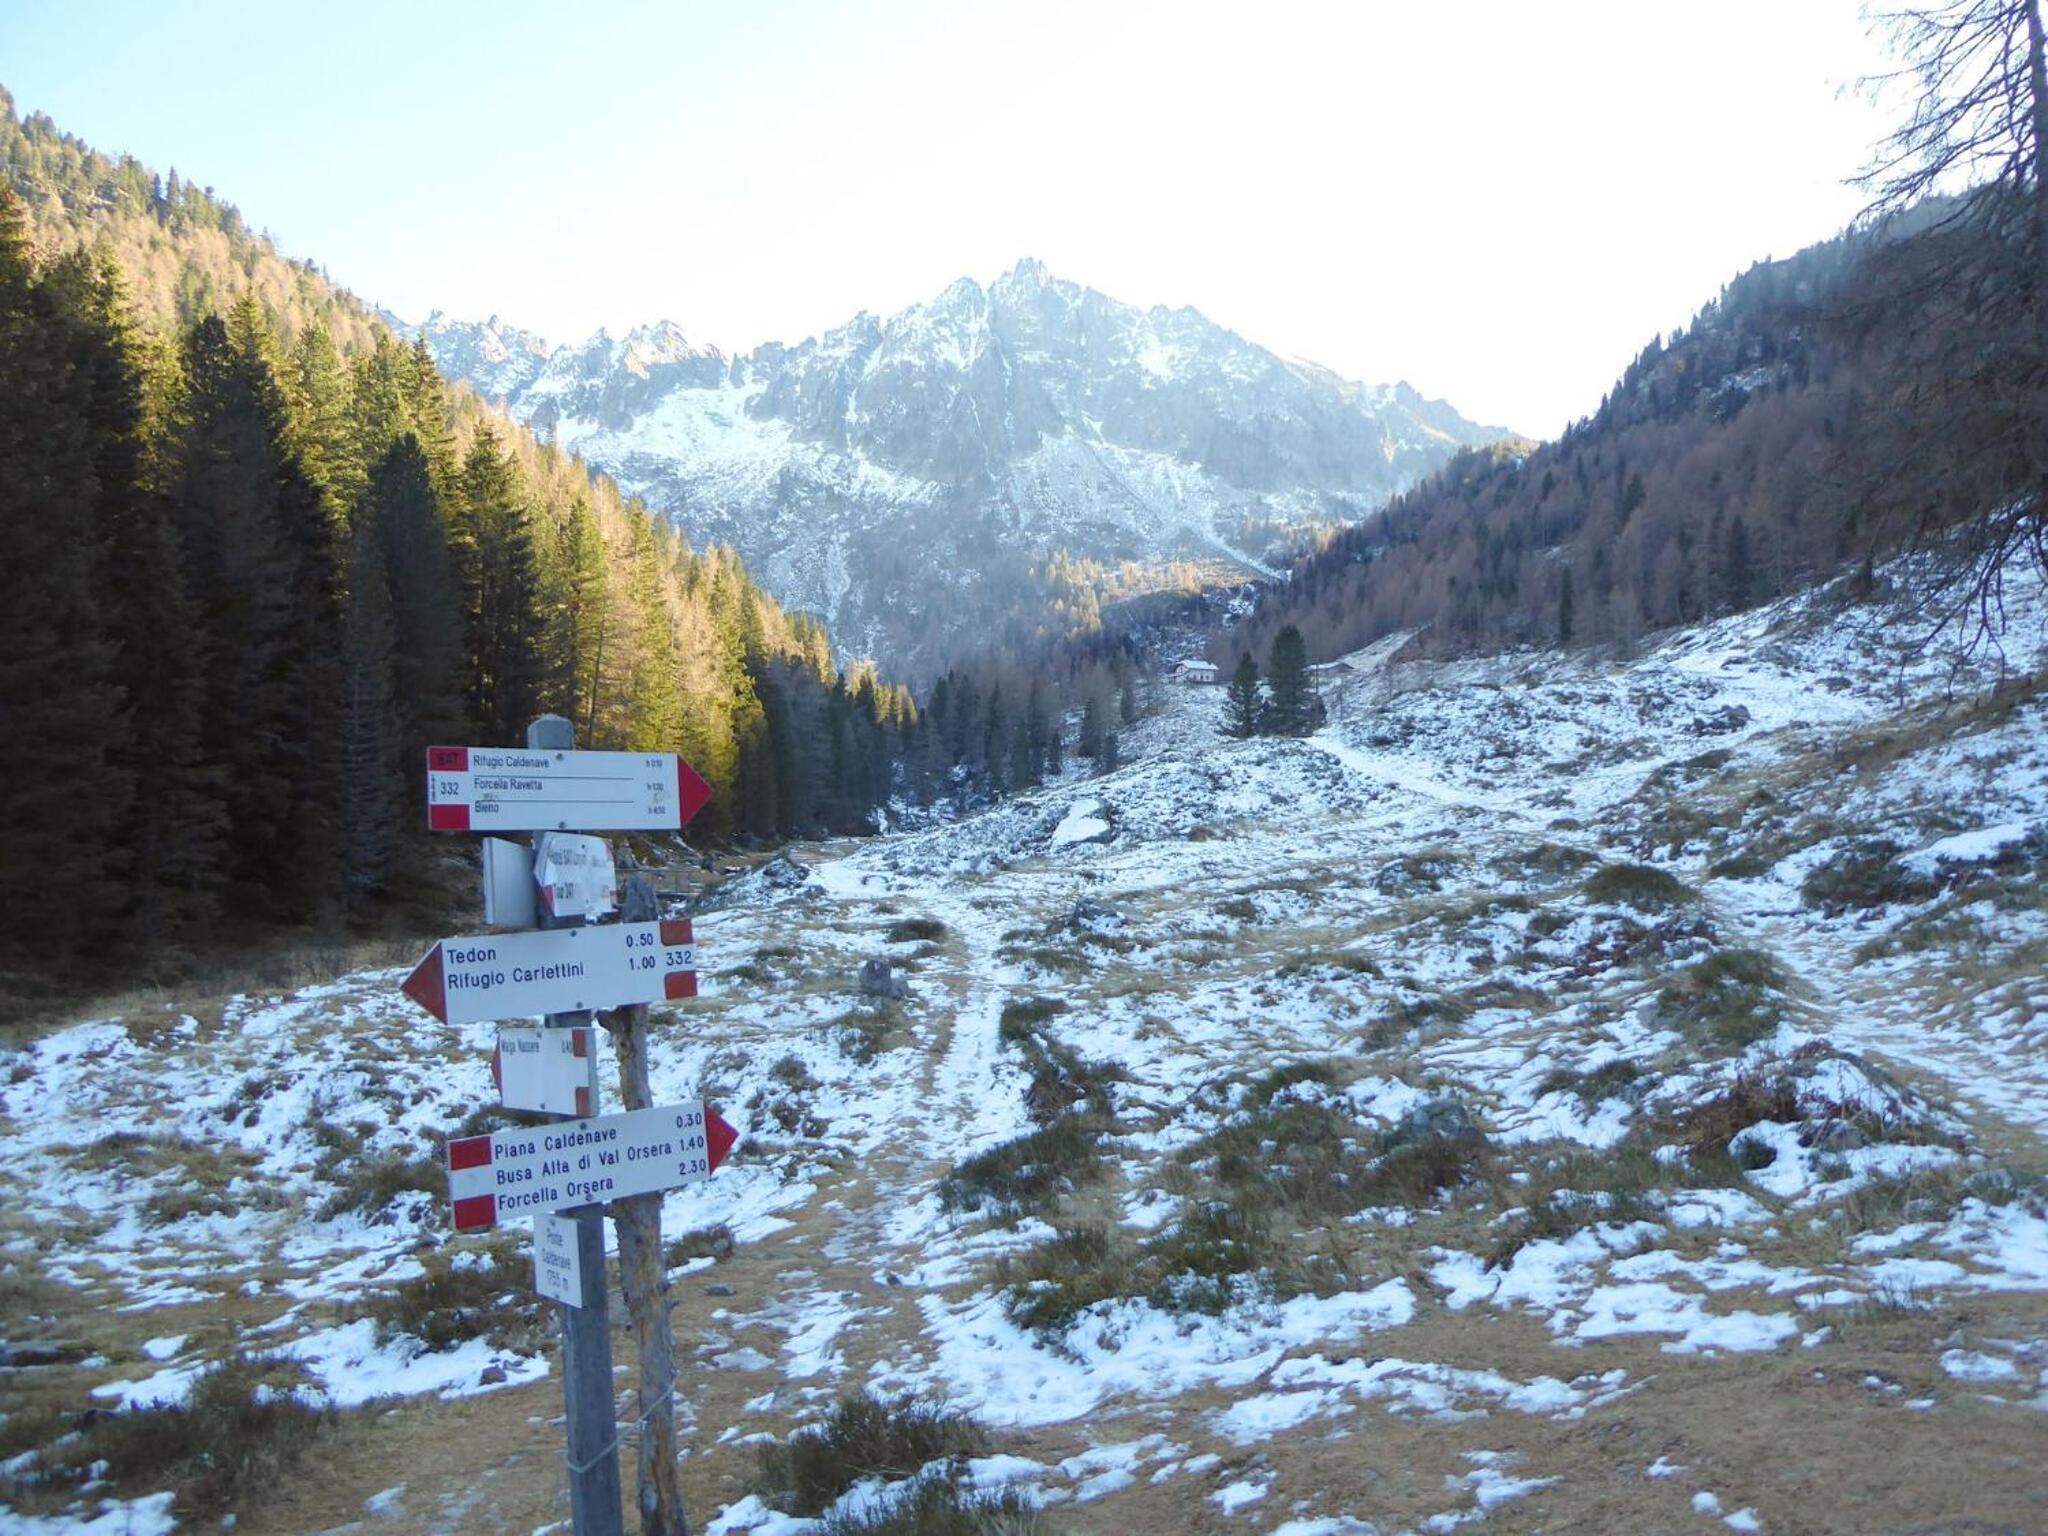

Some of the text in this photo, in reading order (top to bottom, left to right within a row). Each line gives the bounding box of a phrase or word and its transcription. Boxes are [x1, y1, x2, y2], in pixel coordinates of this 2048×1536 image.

[473, 755, 503, 769] Rifugio
[506, 756, 550, 768] Caldenave
[440, 781, 459, 795] 332
[474, 777, 508, 790] Forcella
[510, 778, 543, 790] Ravetta
[474, 801, 499, 813] Bieno
[447, 933, 654, 964] Tedon 0.50
[448, 950, 693, 989] Rifugio Carlettini 1.00 332
[495, 1112, 702, 1160] Piana Caldenave 0.30
[496, 1135, 704, 1185] Busa Alta di Val Orsera 1.40
[498, 1159, 707, 1210] Forcella Orsera 2.30
